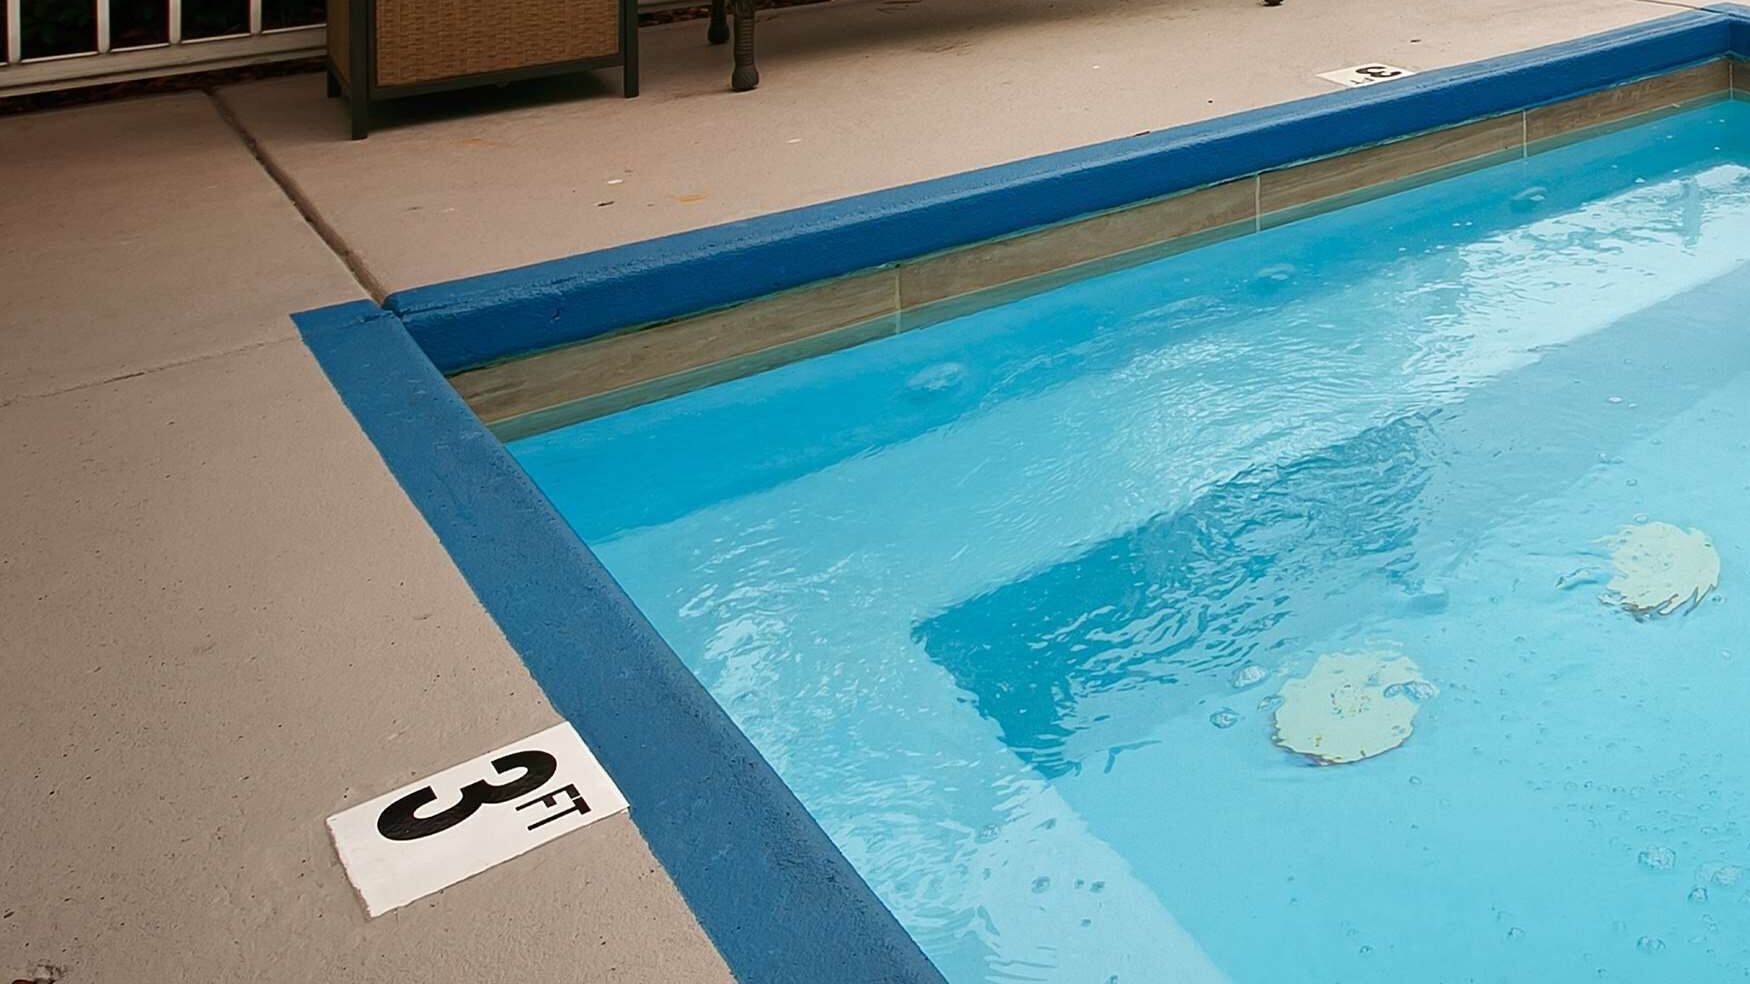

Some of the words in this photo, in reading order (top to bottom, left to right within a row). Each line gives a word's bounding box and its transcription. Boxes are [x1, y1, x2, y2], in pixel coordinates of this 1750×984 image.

[1355, 66, 1402, 78] 3
[377, 750, 558, 841] 3
[515, 783, 592, 831] FT
